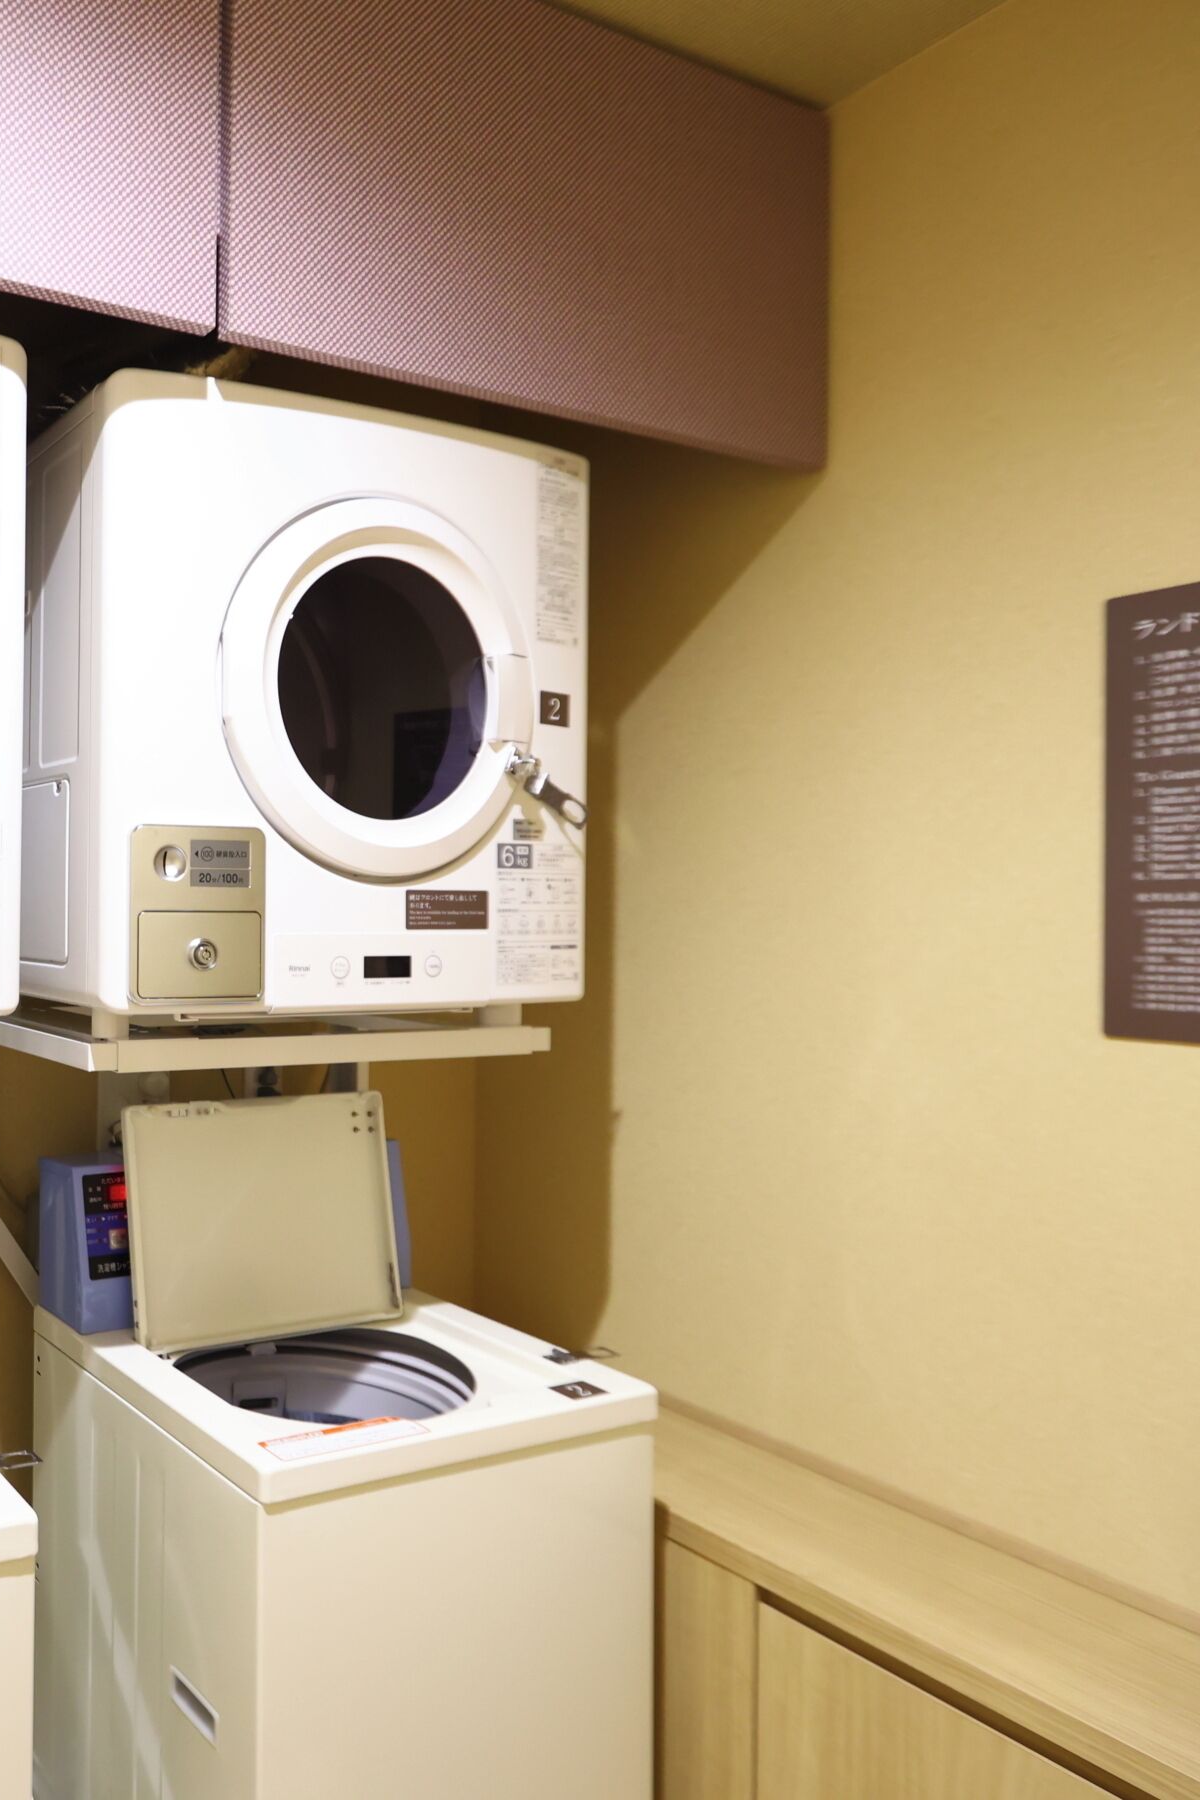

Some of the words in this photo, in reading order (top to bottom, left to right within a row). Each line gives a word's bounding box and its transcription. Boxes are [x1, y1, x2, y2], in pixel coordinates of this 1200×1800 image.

[548, 697, 562, 721] 2
[501, 845, 515, 867] 6
[516, 855, 529, 868] kg
[288, 964, 311, 972] Rinnai
[564, 1380, 593, 1398] 2
